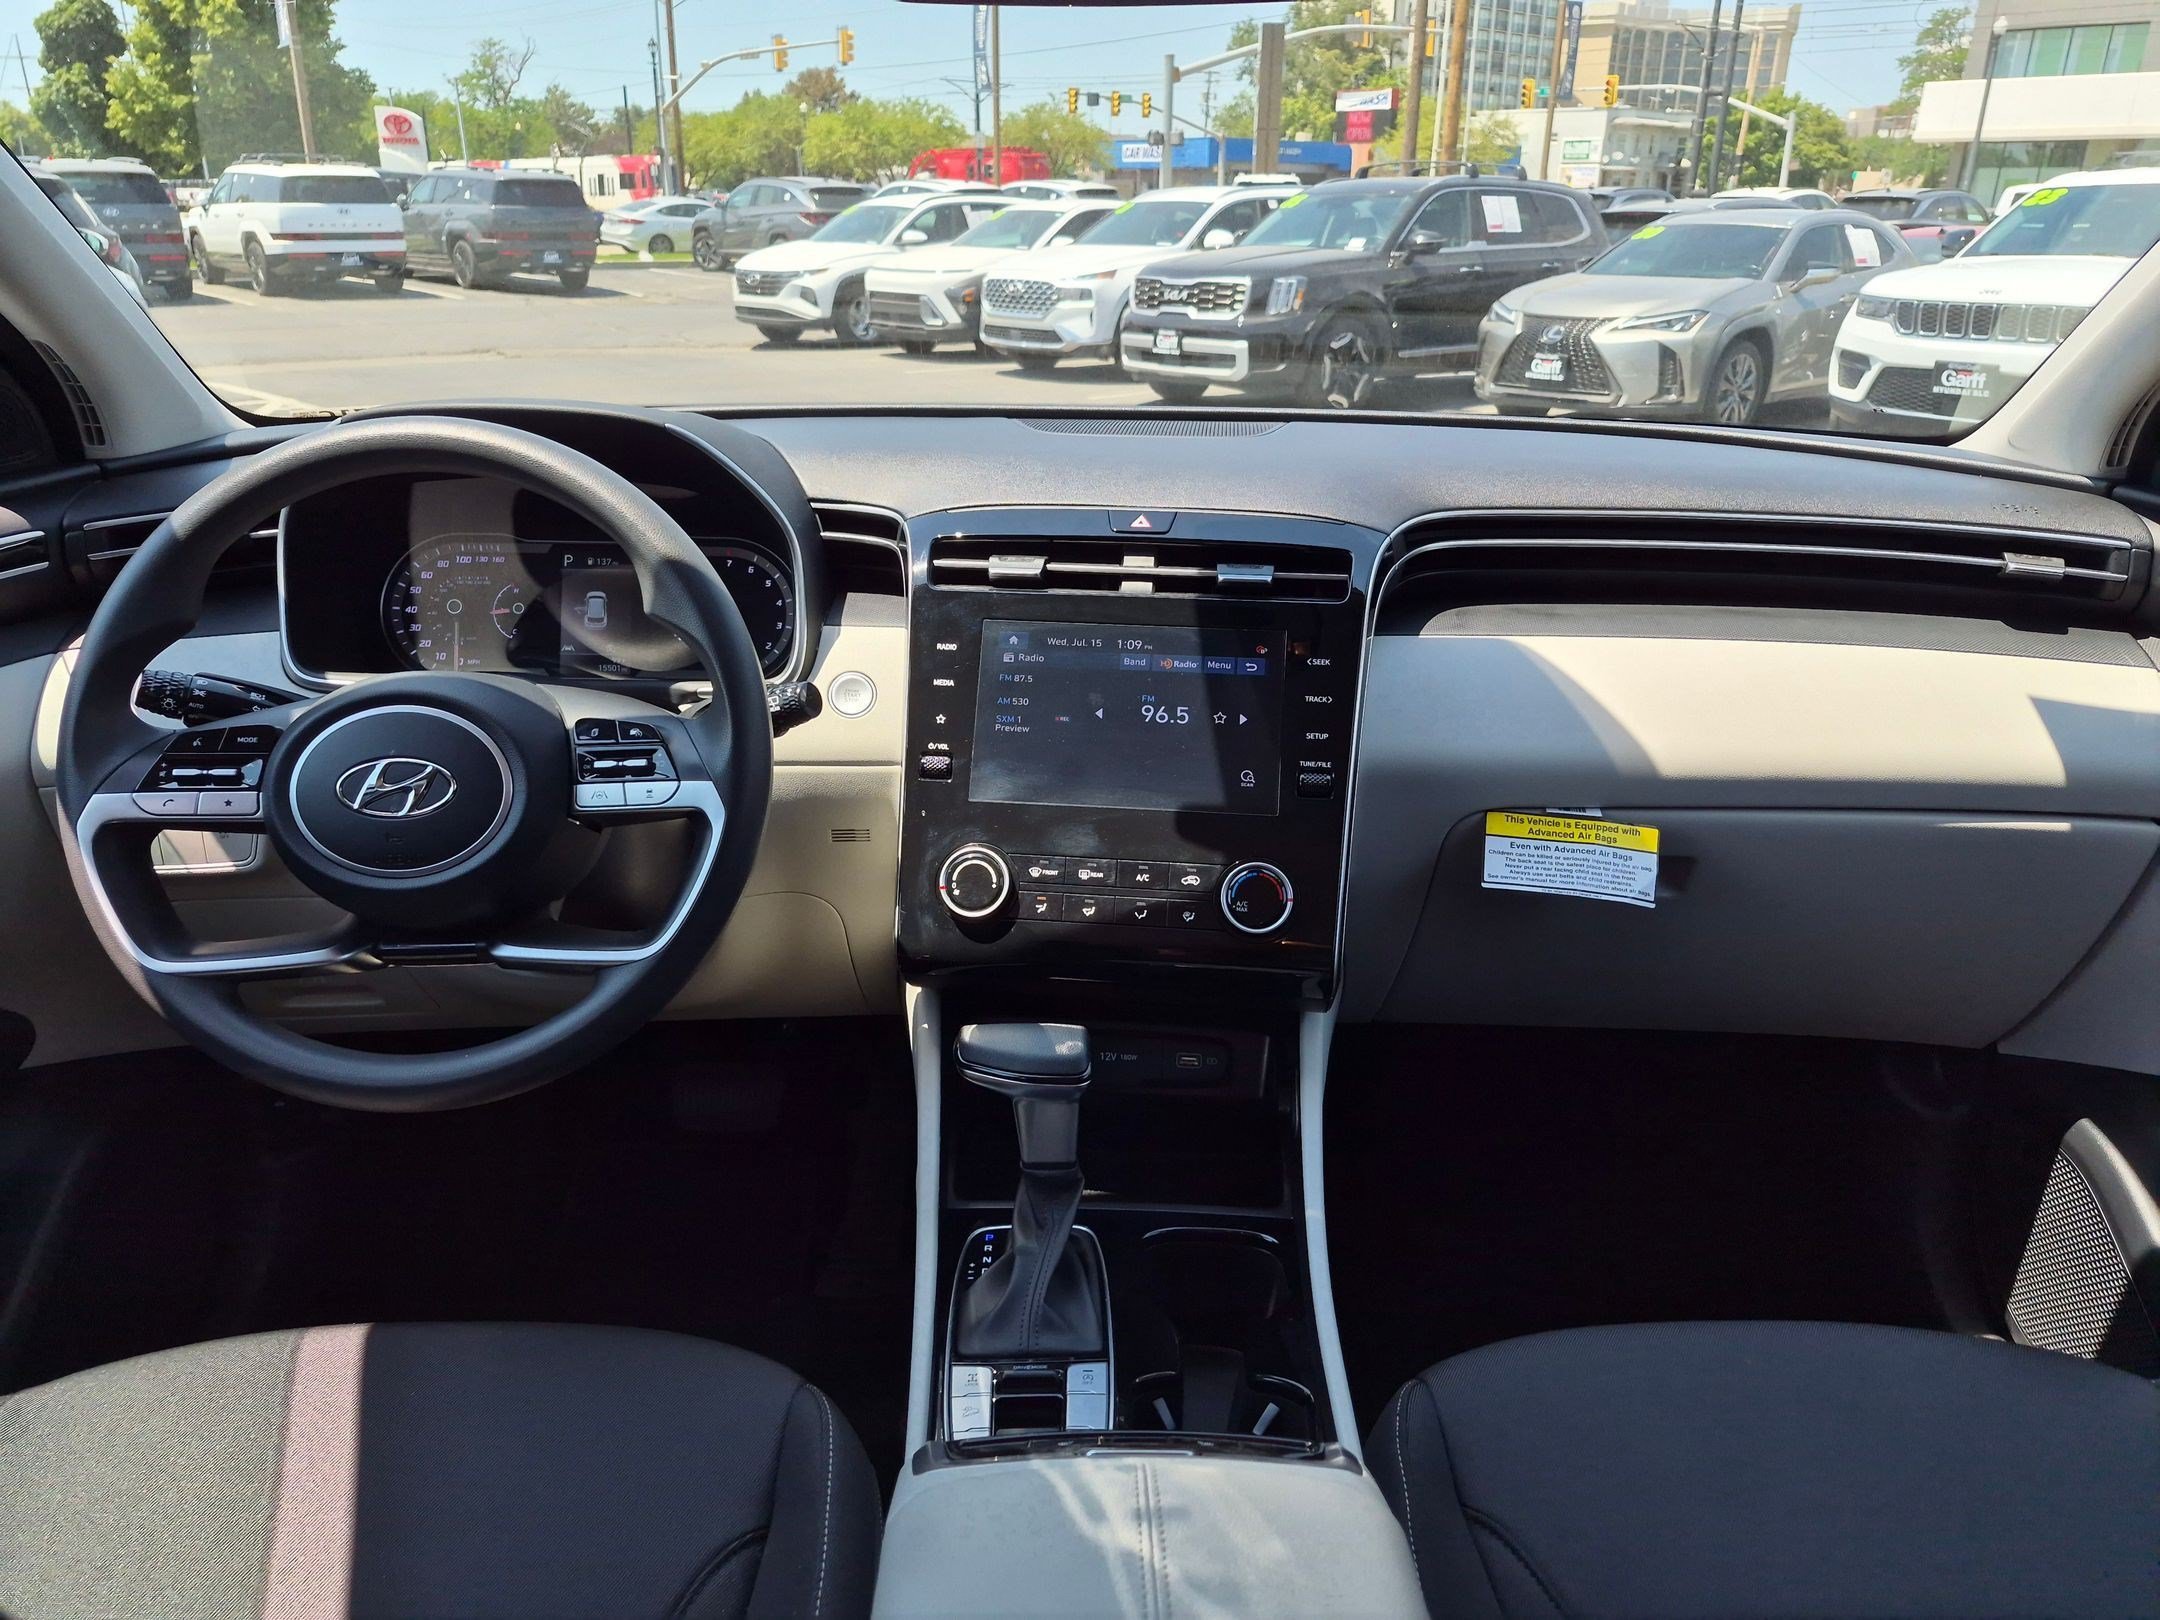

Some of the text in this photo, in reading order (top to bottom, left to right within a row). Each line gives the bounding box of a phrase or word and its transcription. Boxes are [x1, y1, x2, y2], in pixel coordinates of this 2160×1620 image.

[1941, 369, 1986, 389] Garff
[456, 555, 472, 564] 100
[564, 554, 574, 566] P
[597, 558, 612, 566] 137
[421, 571, 433, 579] 60
[409, 586, 422, 594] 50
[409, 624, 422, 632] 30
[419, 639, 432, 648] 20
[765, 642, 772, 650] 2
[936, 643, 958, 651] RADIO
[1071, 638, 1087, 647] Jul.
[1091, 639, 1102, 647] 15
[1117, 640, 1142, 650] 1:09
[435, 652, 447, 660] 10
[1018, 653, 1045, 663] Radio
[1123, 657, 1146, 666] Band
[1207, 661, 1232, 670] Menu
[598, 664, 620, 672] 15501
[933, 679, 955, 687] MEDIA
[1013, 675, 1033, 683] 87.5
[1012, 698, 1029, 706] 530
[1141, 695, 1155, 703] FM
[996, 714, 1015, 723] SXM
[1141, 704, 1189, 724] 96.5
[995, 724, 1031, 733] Preview
[1300, 760, 1332, 768] TUNE/FILE
[1504, 814, 1641, 837] This Vehicle is Equipped with
[1528, 827, 1617, 844] Advanced Air Bags
[1510, 842, 1531, 850] Even
[1554, 846, 1596, 855] Advanced
[1612, 852, 1632, 862] Bags
[1592, 858, 1611, 866] injured
[1135, 873, 1150, 882] A/C
[1576, 880, 1610, 890] information
[1100, 1052, 1117, 1061] 12V
